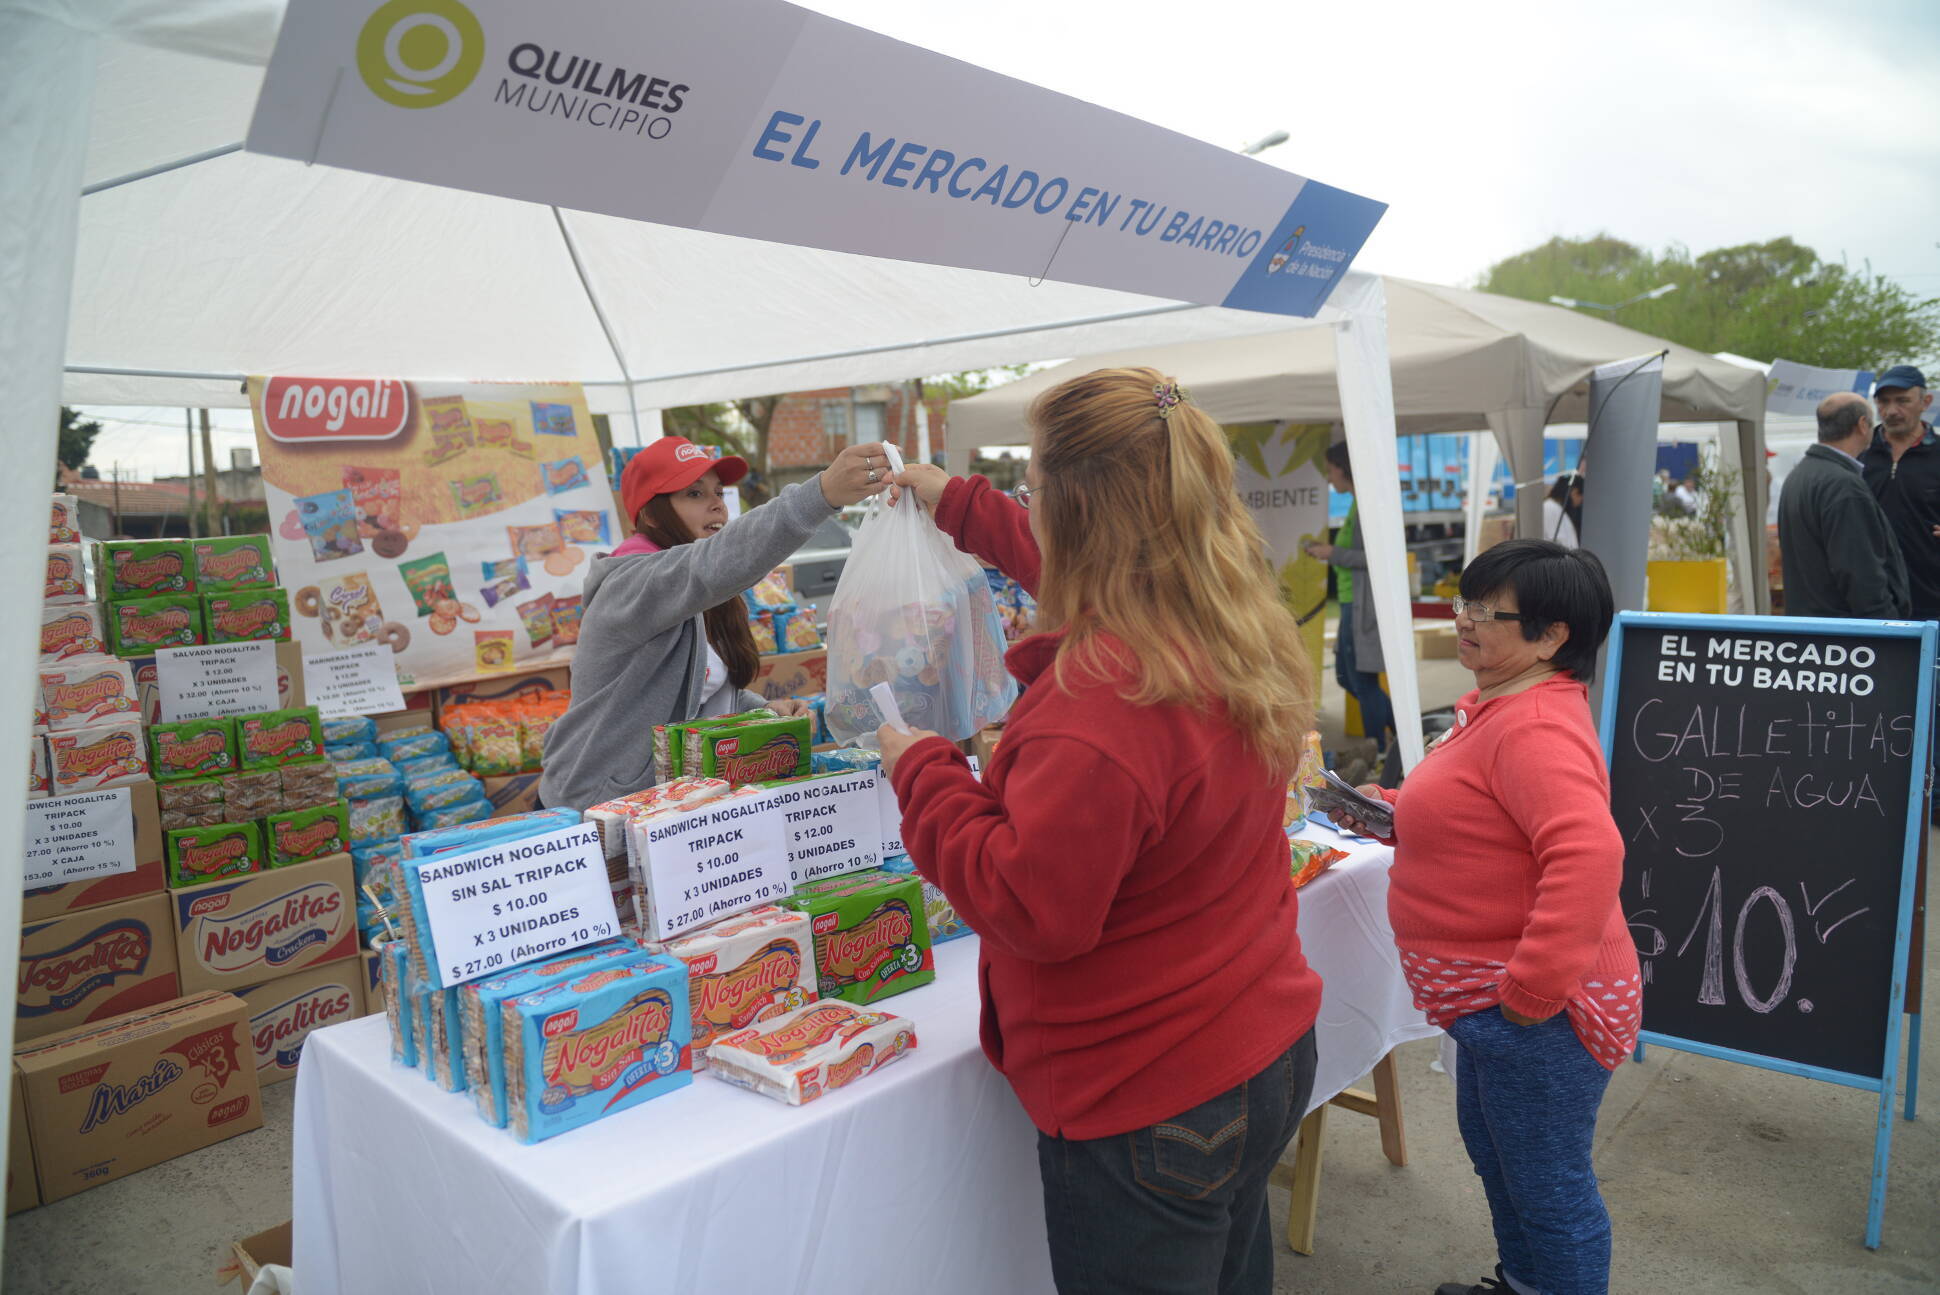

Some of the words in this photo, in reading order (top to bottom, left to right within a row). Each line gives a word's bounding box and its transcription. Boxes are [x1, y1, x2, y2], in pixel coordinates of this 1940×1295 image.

[508, 43, 690, 114] QUILMES
[494, 78, 672, 140] MUNICIPIO
[753, 110, 821, 169] EL
[840, 132, 1069, 214] MERCADO
[1065, 187, 1121, 226] EN
[1119, 199, 1166, 236] TU
[1160, 211, 1262, 258] BARRIO
[277, 378, 393, 433] nogali
[172, 649, 213, 659] SALVADO
[214, 644, 261, 655] NOGALITAS
[200, 657, 237, 667] TRIPACK
[1661, 634, 1696, 658] EL
[1708, 638, 1876, 668] MERCADO
[207, 676, 247, 687] UNIDADES
[213, 668, 233, 676] 12.00
[1658, 660, 1696, 683] EN
[1706, 664, 1744, 687] TU
[1753, 668, 1875, 696] BARRIO
[52, 680, 124, 706] Nogalitas
[186, 690, 207, 699] 32.00
[215, 697, 237, 706] CAJA
[184, 711, 209, 720] 153.00
[723, 746, 799, 786] Nogalitas
[804, 778, 875, 800] NOGALITAS
[1683, 767, 1743, 802] DE
[1767, 766, 1885, 817] AGUA
[26, 800, 62, 811] DWICH
[64, 793, 118, 807] NOGALITAS
[785, 804, 837, 824] TRIPACK
[44, 809, 86, 821] TRIPACK
[59, 821, 82, 830] 10.00
[650, 815, 708, 843] SANDWICH
[711, 797, 781, 824] NOGALITAS
[52, 830, 98, 843] UNIDADES
[688, 829, 744, 853] TRIPACK
[794, 831, 801, 842] $
[804, 824, 833, 840] 12.00
[1674, 804, 1725, 858] 3
[26, 848, 52, 858] 27.00
[56, 844, 89, 855] (Ahorro
[61, 855, 85, 864] CAJA
[421, 853, 504, 884] SANDWICH
[509, 831, 600, 862] NOGALITAS
[697, 862, 703, 873] $
[706, 852, 739, 870] 10.00
[787, 852, 794, 862] 3
[798, 839, 855, 860] UNIDADES
[24, 871, 53, 881] 153.00
[63, 864, 95, 876] (Ahorro
[804, 861, 844, 880] (Ahorro
[847, 856, 861, 868] 10
[864, 852, 877, 864] %)
[451, 885, 477, 902] SIN
[481, 877, 512, 894] SAL
[515, 857, 588, 885] TRIPACK
[684, 890, 691, 901] X
[694, 886, 699, 897] 3
[702, 867, 763, 894] UNIDADES
[195, 895, 228, 912] nogali
[493, 904, 501, 916] $
[506, 891, 548, 912] 10.00
[667, 919, 674, 930] $
[677, 907, 704, 928] 27.00
[709, 894, 751, 915] (Ahorro
[755, 886, 769, 899] 10
[772, 881, 787, 894] %)
[204, 891, 341, 963] Nogalitas
[474, 934, 484, 947] X
[487, 930, 496, 942] 3
[500, 907, 580, 938] UNIDADES
[815, 915, 838, 932] nogali
[277, 931, 316, 960] Crackers
[452, 966, 461, 979] $
[465, 953, 503, 975] 27.00
[510, 937, 566, 962] (Ahorro
[571, 928, 589, 943] 10
[593, 922, 611, 936] %)
[822, 911, 912, 973] Nogalitas
[689, 954, 716, 975] nogali
[900, 943, 918, 967] x3
[858, 965, 872, 979] Con
[880, 960, 901, 979] OFERTA
[692, 954, 800, 1019] Nogalitas
[252, 992, 350, 1056] galitas
[546, 1010, 577, 1032] nogali
[758, 1006, 856, 1055] Nogalitas
[549, 1005, 672, 1083] Nogalitas
[653, 1041, 675, 1068] x3
[200, 1046, 229, 1079] x3
[600, 1067, 619, 1086] Sin
[618, 1050, 636, 1072] Sal
[626, 1063, 654, 1086] OFERTA
[211, 1101, 243, 1119] nogali
